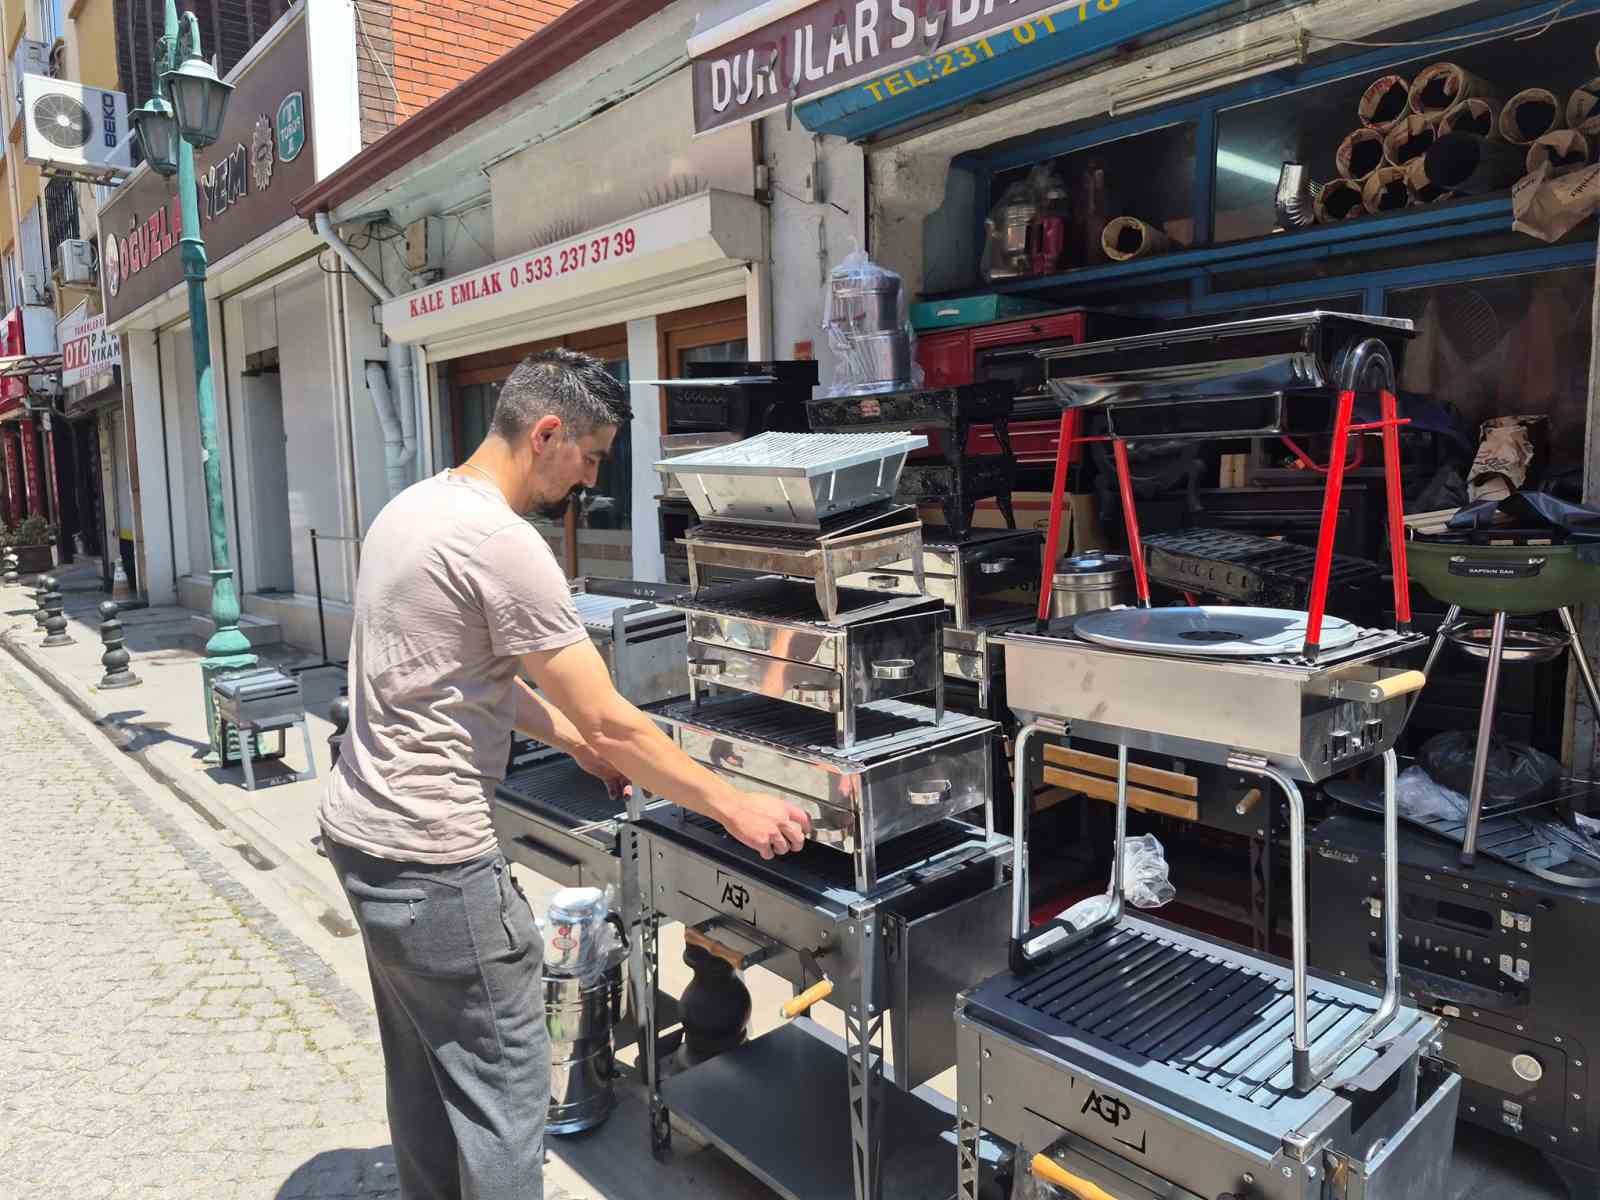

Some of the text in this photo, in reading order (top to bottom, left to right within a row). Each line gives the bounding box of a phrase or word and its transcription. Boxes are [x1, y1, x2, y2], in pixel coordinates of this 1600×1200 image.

[103, 92, 118, 149] BEKO
[201, 142, 248, 220] YEM
[409, 288, 445, 318] KALE
[451, 271, 503, 306] EMLAK
[65, 337, 89, 370] OTO
